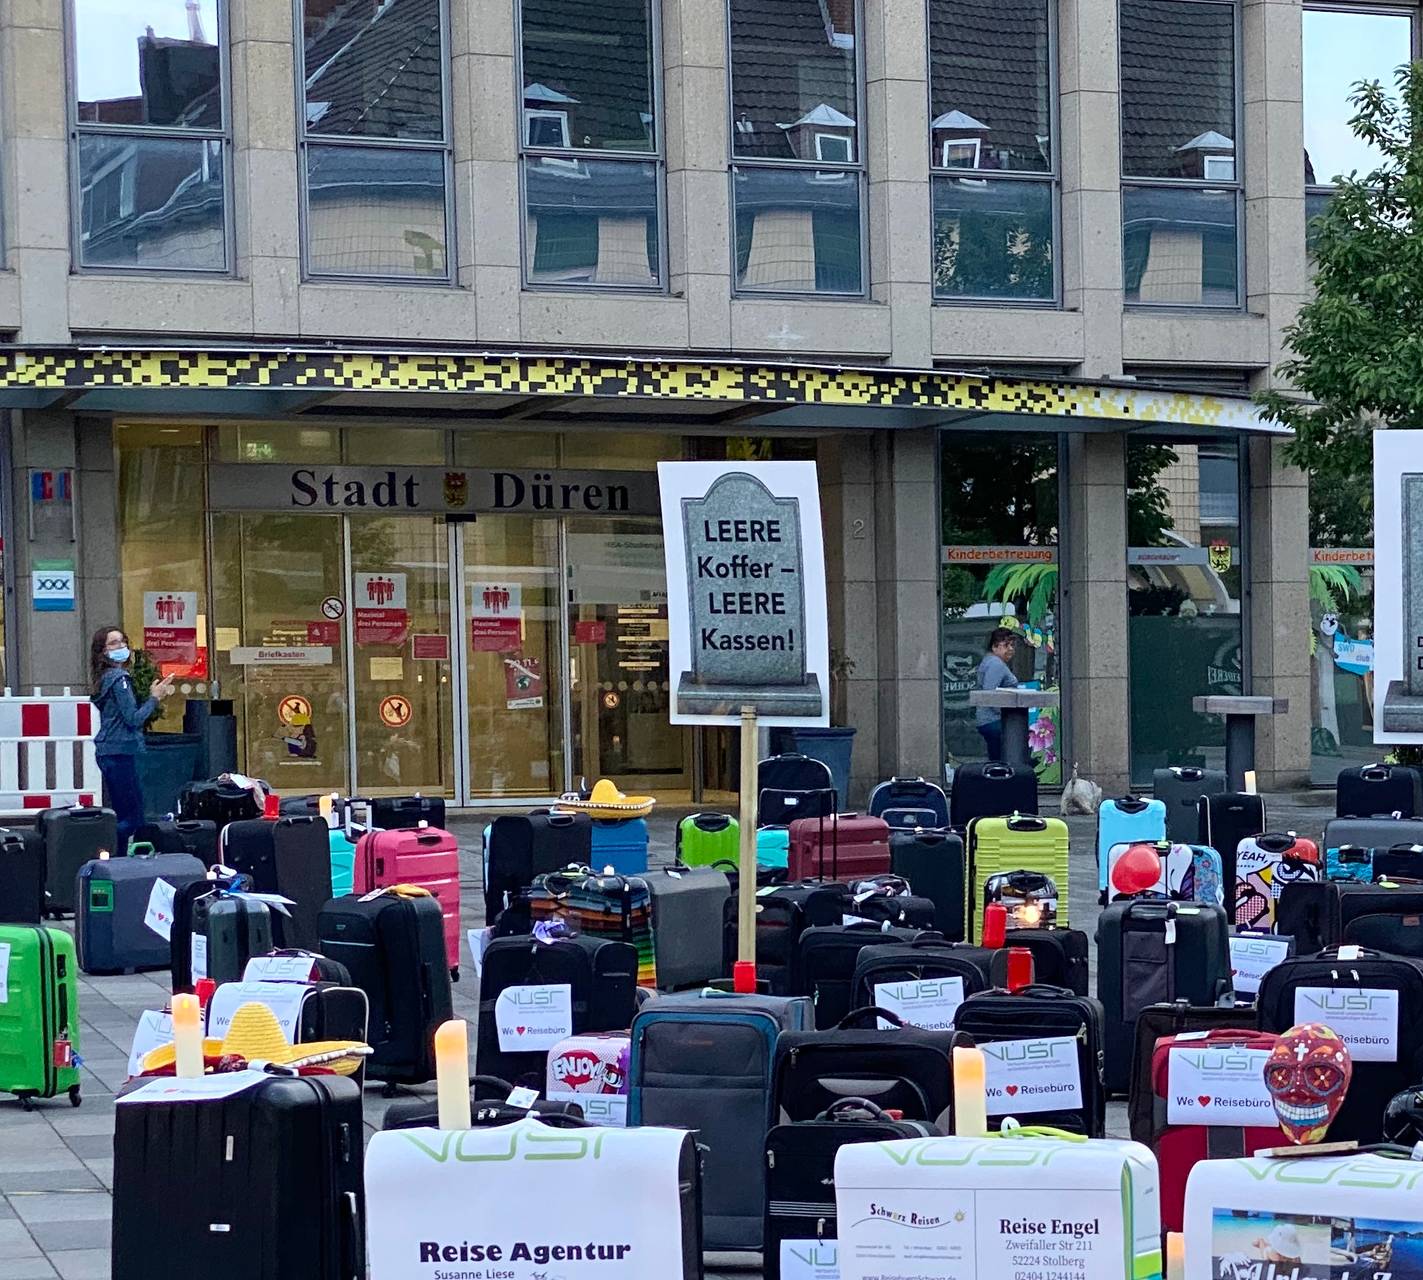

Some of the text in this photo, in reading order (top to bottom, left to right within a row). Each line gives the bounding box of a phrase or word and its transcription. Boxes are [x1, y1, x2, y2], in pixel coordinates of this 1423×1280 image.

[291, 469, 630, 511] Stadt Düren
[704, 520, 782, 542] LEERE
[853, 519, 865, 539] 2
[948, 549, 1052, 562] Kinderbetreuung
[697, 555, 774, 579] Koffer
[709, 592, 786, 615] LEERE
[701, 628, 794, 651] Kassen!
[258, 650, 306, 659] Briefkasten
[502, 1026, 566, 1036] We Reisebüro
[986, 1083, 1075, 1098] We Reisebüro
[1176, 1096, 1271, 1108] We Reisebüro
[870, 1203, 906, 1222] Schwarz
[999, 1217, 1100, 1240] Reise Engel
[419, 1240, 631, 1265] Reise Agentur
[1005, 1239, 1093, 1251] Zweifaller Str 211
[1011, 1255, 1085, 1270] 52224 Stolberg
[434, 1268, 515, 1280] Susanne Liese
